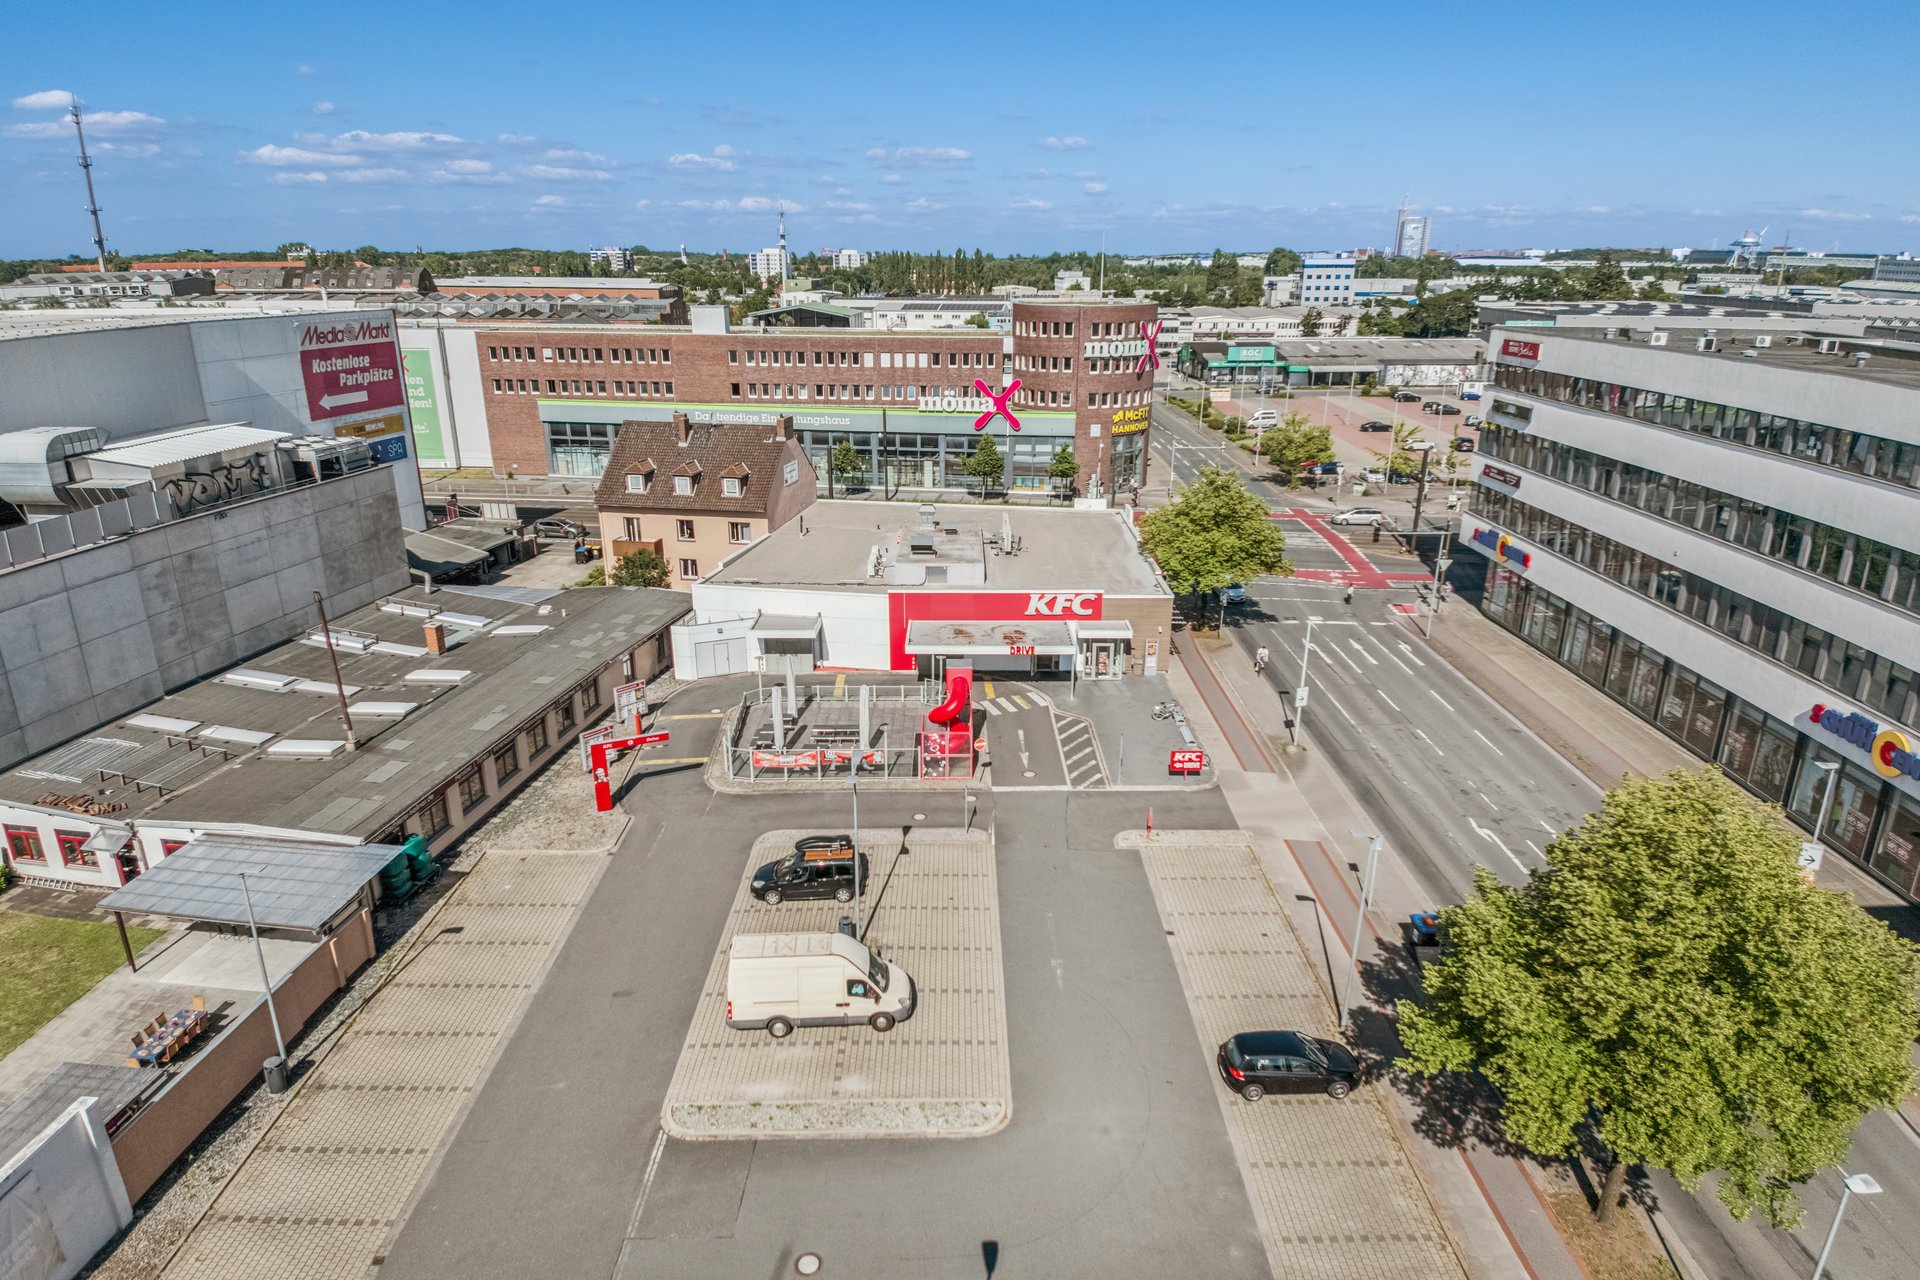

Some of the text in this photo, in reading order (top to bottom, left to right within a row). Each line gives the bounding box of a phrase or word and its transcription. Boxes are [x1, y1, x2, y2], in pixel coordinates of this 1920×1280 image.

[301, 321, 391, 347] Media Markt
[312, 355, 370, 374] Kostenlose
[339, 368, 394, 387] Parkplätze
[716, 412, 760, 425] trendige
[761, 414, 851, 426] Eintungshaus
[1024, 593, 1098, 616] KFC
[1009, 646, 1035, 656] DRIVE
[1173, 752, 1202, 762] KFC
